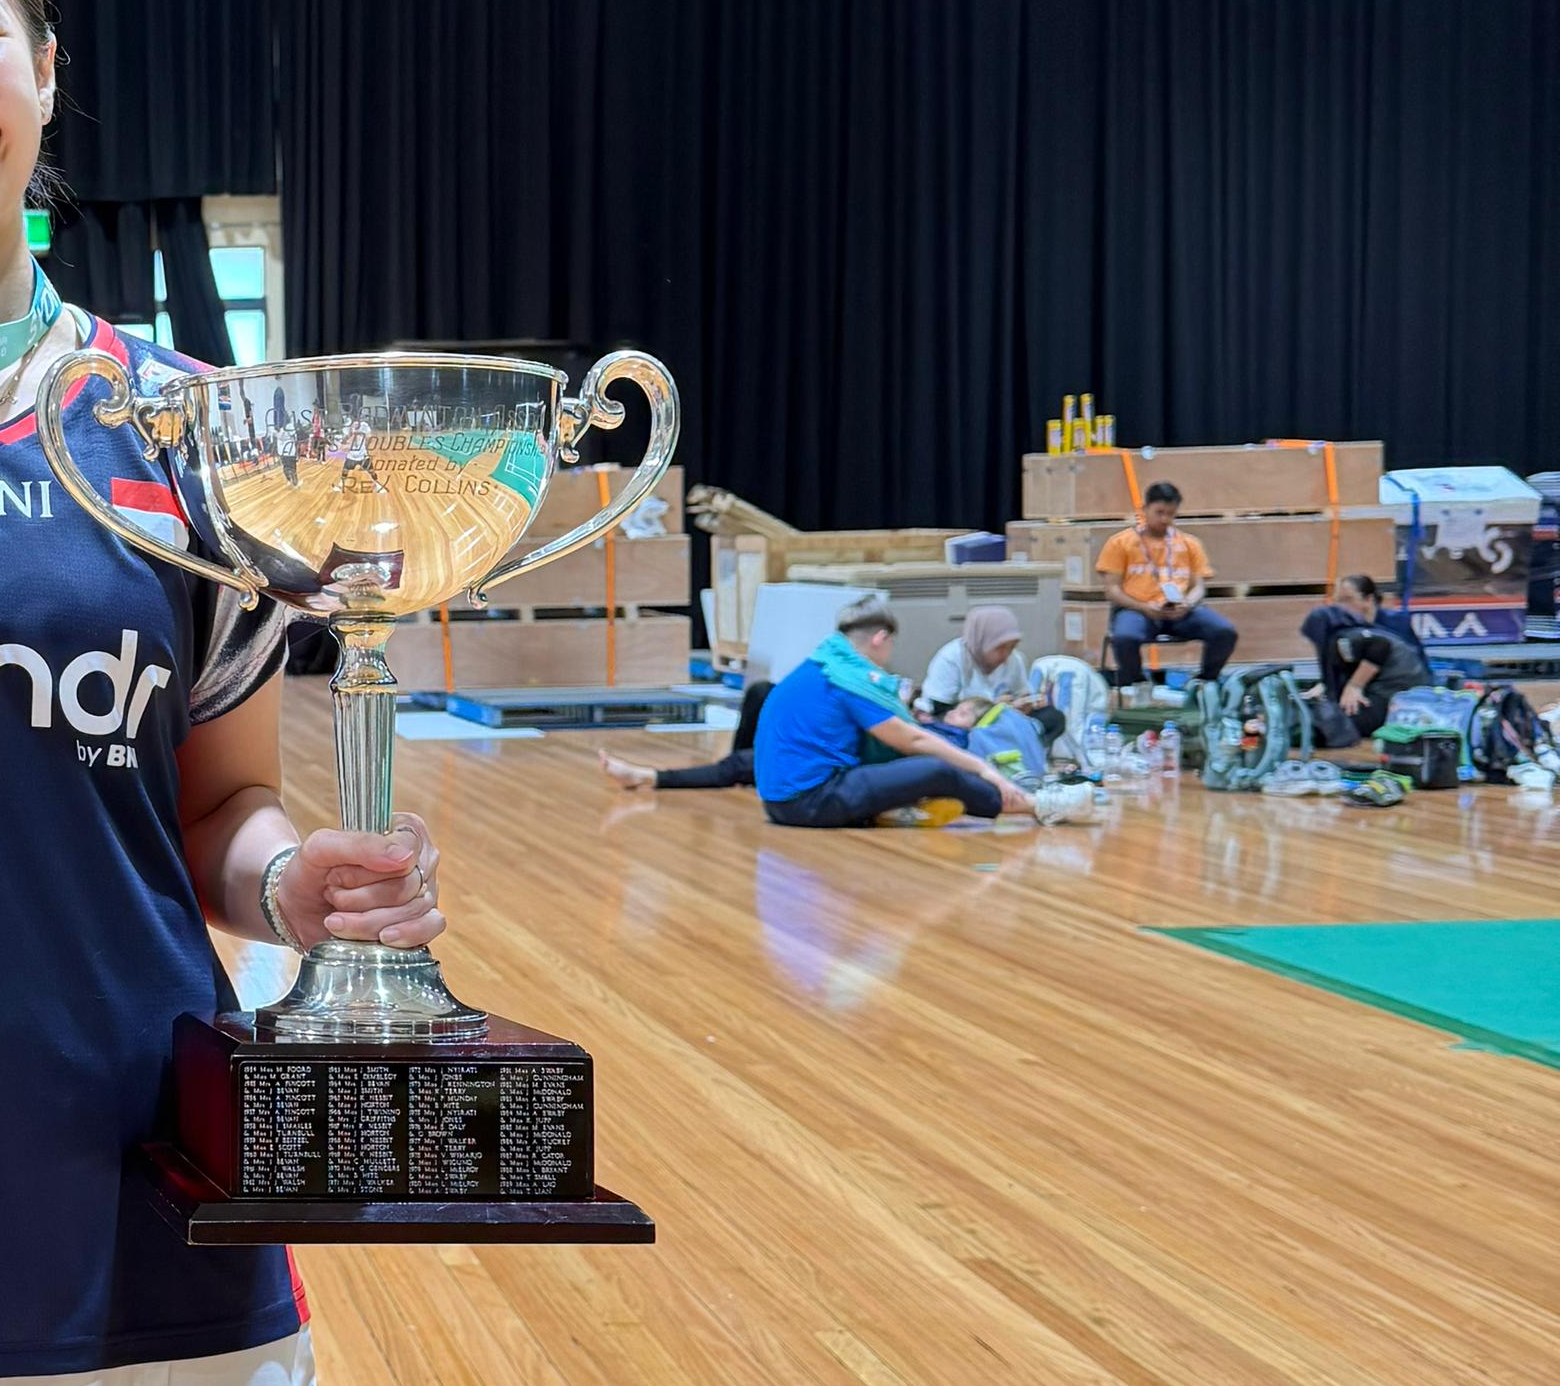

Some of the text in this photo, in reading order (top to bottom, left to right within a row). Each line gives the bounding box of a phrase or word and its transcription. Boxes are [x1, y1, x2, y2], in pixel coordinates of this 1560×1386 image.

[350, 431, 446, 452] DOUBLES
[405, 474, 491, 496] COLLINS
[76, 739, 103, 768] by
